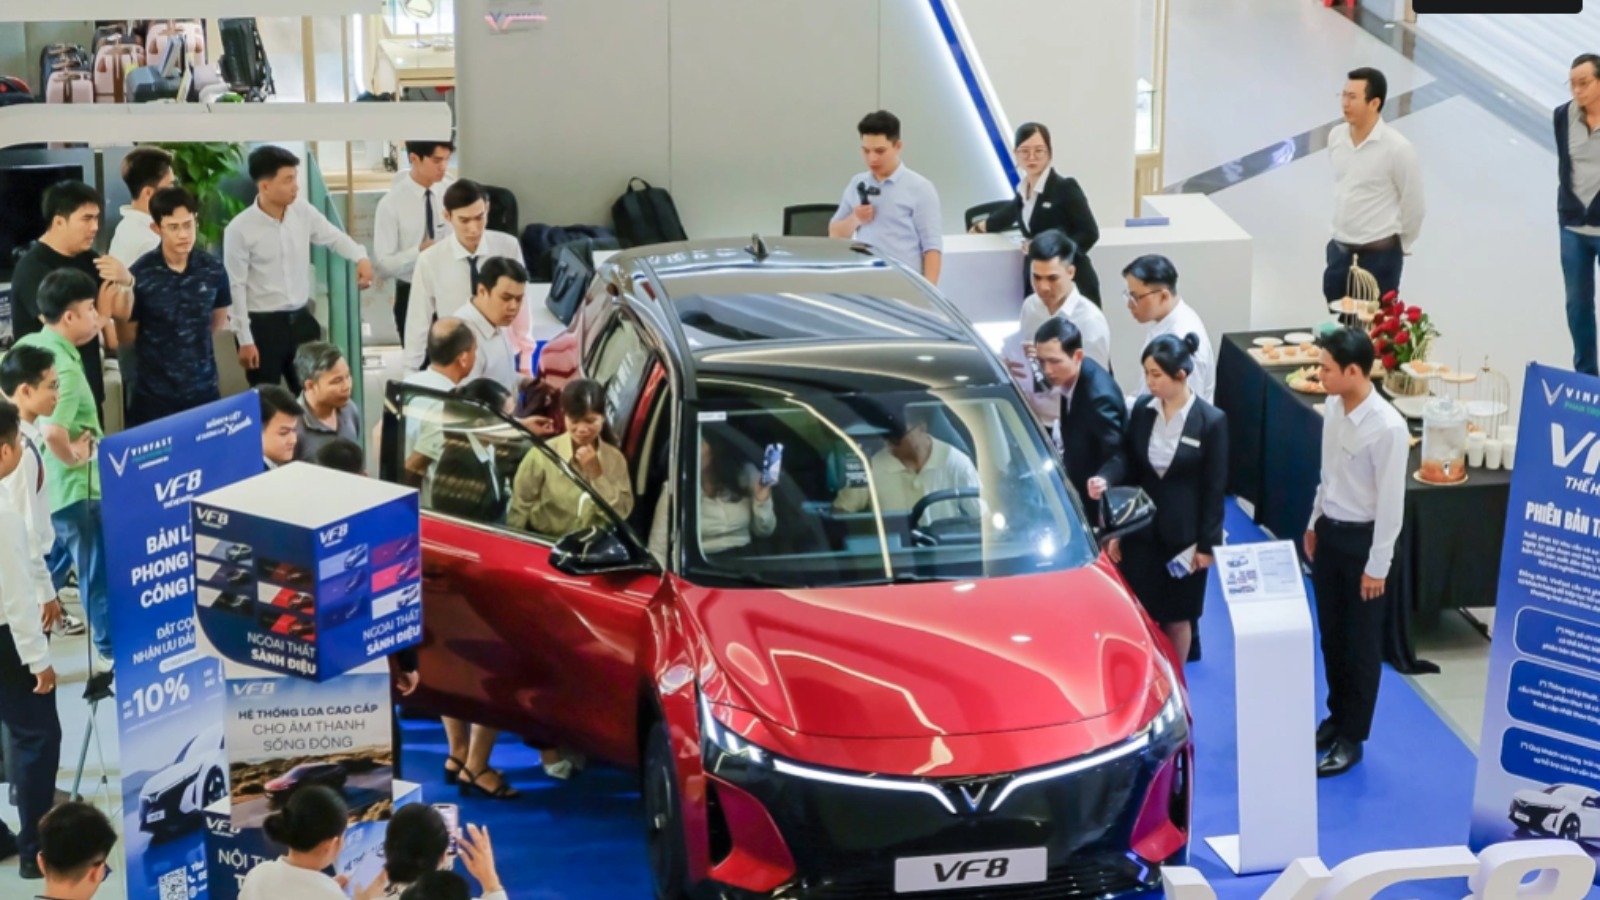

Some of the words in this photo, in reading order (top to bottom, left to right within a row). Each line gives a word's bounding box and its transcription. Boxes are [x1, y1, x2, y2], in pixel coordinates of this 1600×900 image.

[131, 436, 172, 457] VINFAST
[154, 469, 202, 502] VF8
[196, 506, 229, 526] VF8
[1525, 501, 1562, 528] PHIÊN
[1564, 507, 1589, 535] BẢN
[146, 527, 179, 556] BẢN
[320, 523, 348, 545] VF8
[131, 551, 189, 587] PHONG
[140, 577, 188, 609] CÔNG
[365, 635, 395, 657] SÀNH
[395, 624, 420, 644] ĐIỆU
[250, 648, 285, 667] SÀNH
[286, 656, 317, 676] ĐIỆU
[132, 672, 190, 718] 10%
[232, 682, 276, 697] VF8
[257, 706, 299, 719] THỐNG
[301, 706, 325, 717] LOA
[326, 705, 351, 716] CAO
[353, 702, 378, 715] CẤP
[252, 723, 286, 736] CHO
[288, 720, 312, 734] ÂM
[315, 718, 366, 732] THANH
[263, 737, 306, 752] SỐNG
[308, 735, 353, 750] ĐỘNG
[218, 848, 248, 869] NỘI
[934, 857, 1009, 882] VF8
